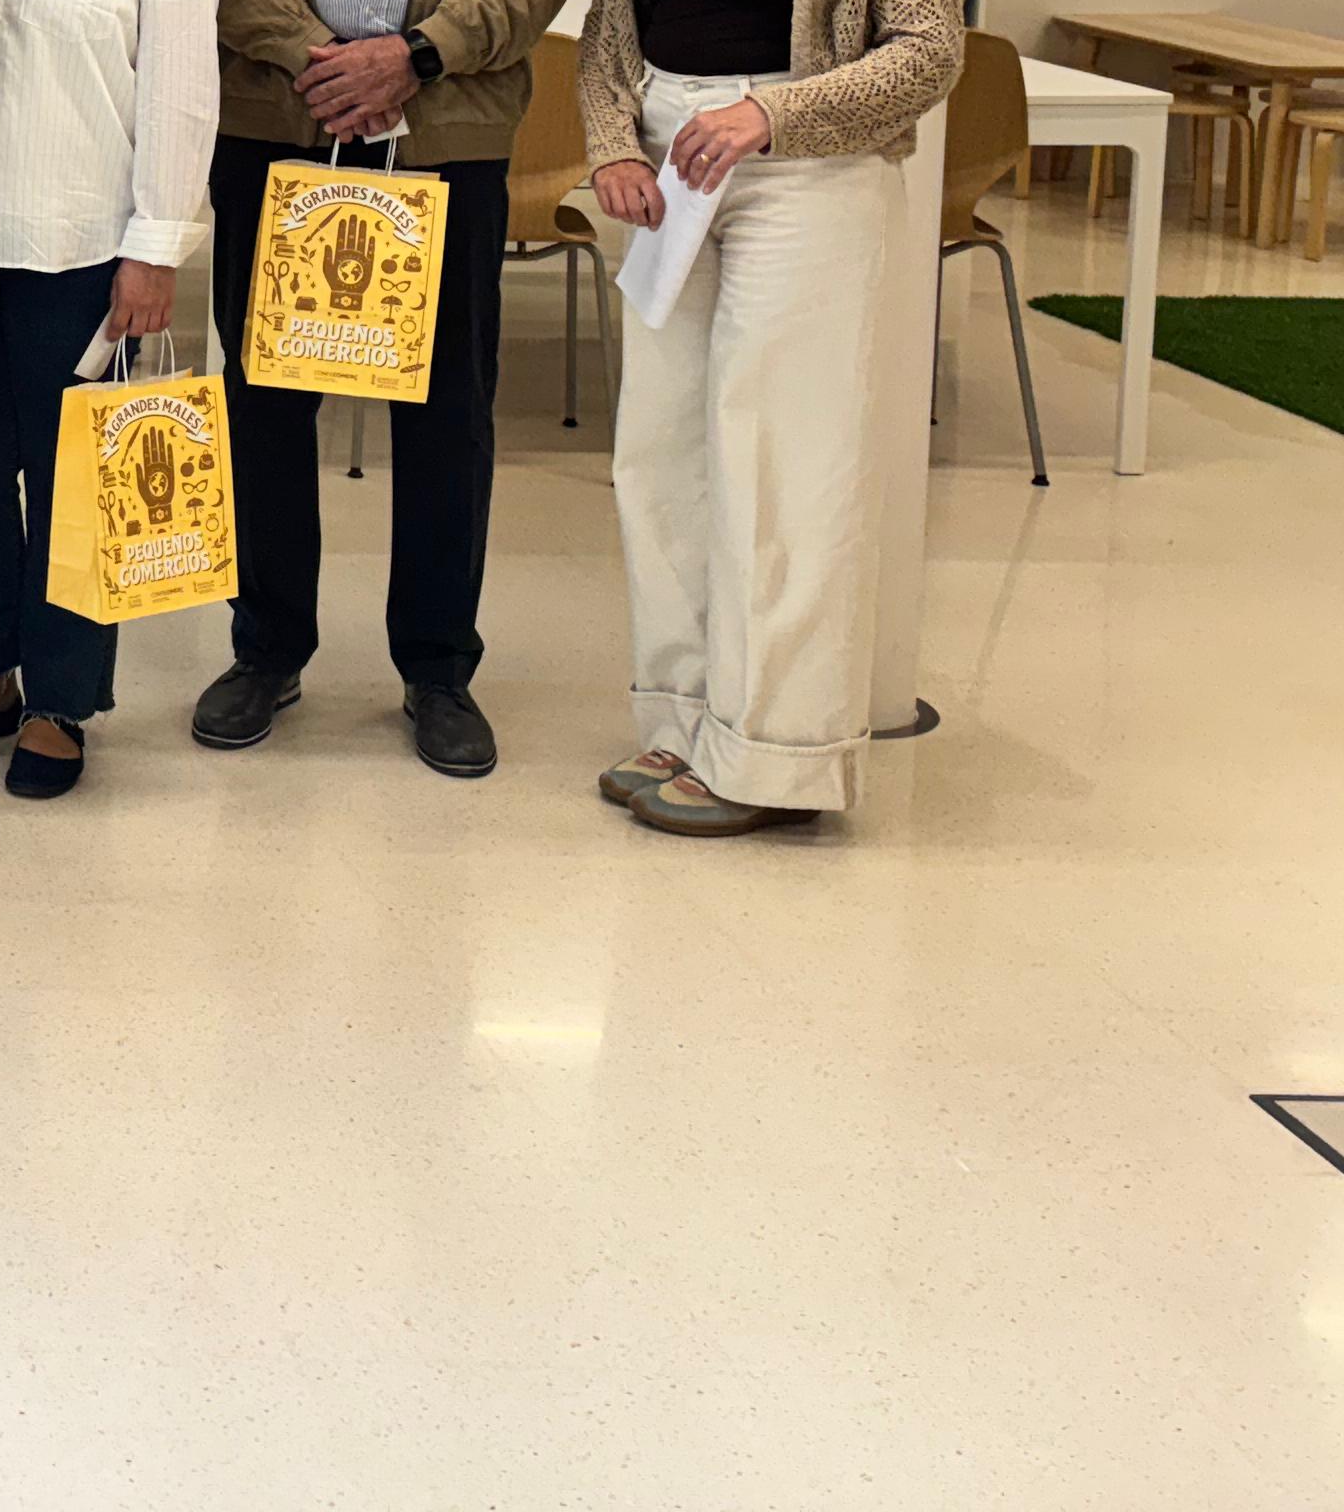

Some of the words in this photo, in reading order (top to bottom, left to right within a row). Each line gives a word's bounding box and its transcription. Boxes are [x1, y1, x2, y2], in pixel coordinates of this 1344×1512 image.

[301, 185, 368, 208] GRANDES
[370, 192, 414, 229] MALES
[289, 316, 396, 347] PEQUEÑOS
[276, 337, 401, 370] COMERCIOS
[111, 398, 160, 430] GRANDES
[162, 399, 202, 429] MALES
[125, 531, 204, 564] PEQUEÑOS
[118, 552, 212, 588] COMERCIOS
